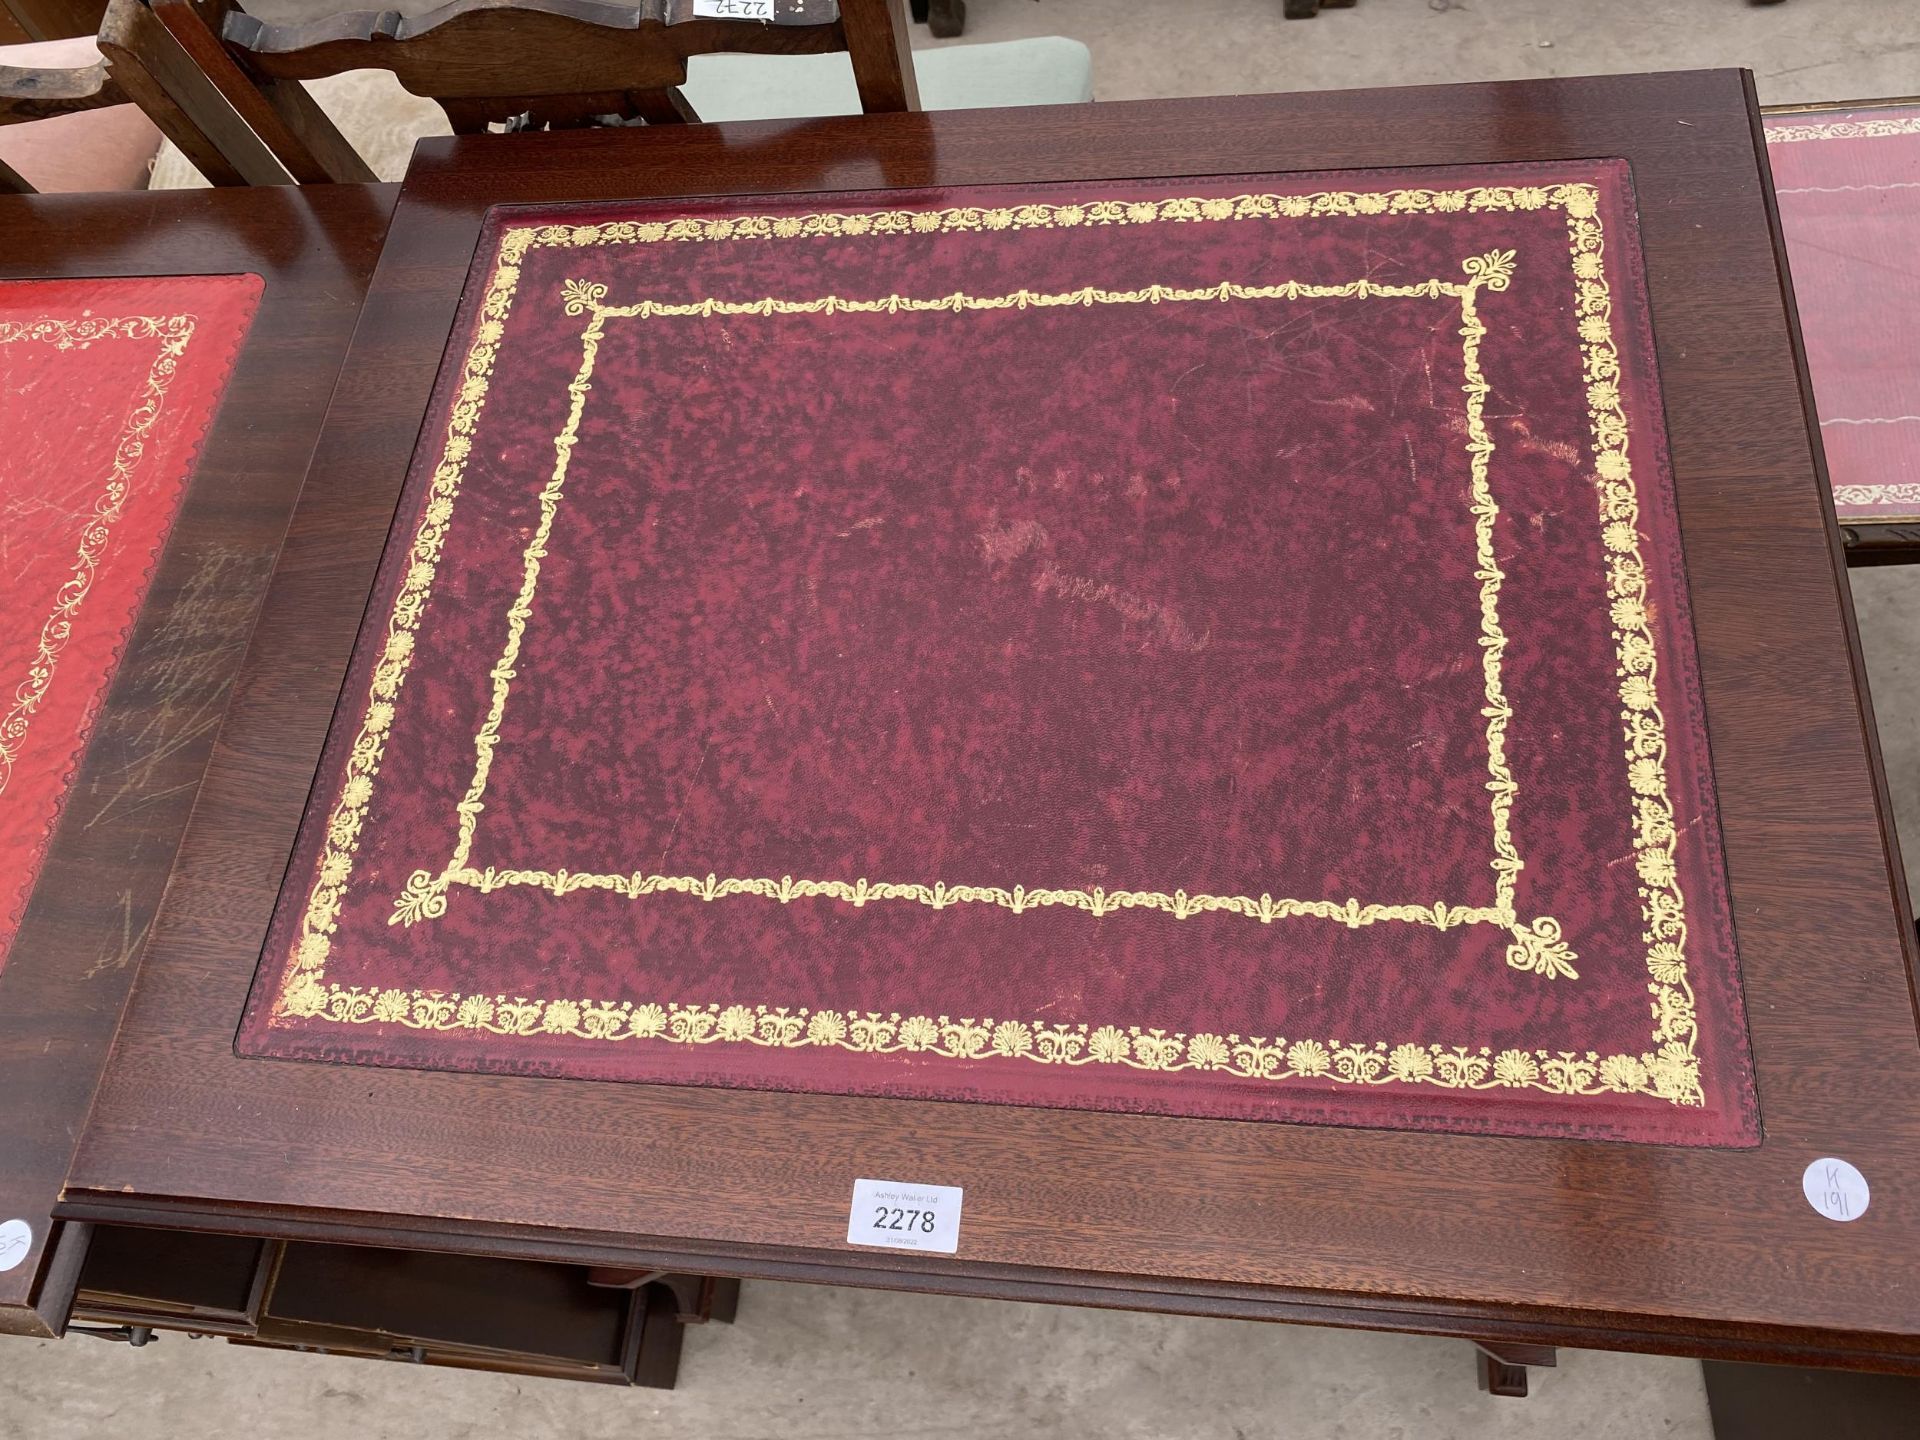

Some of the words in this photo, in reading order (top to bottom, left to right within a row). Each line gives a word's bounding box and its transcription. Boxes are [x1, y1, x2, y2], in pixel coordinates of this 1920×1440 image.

[704, 0, 767, 15] 2272
[1825, 1166, 1839, 1190] K
[1824, 1192, 1849, 1216] 191
[873, 1206, 935, 1233] 2278
